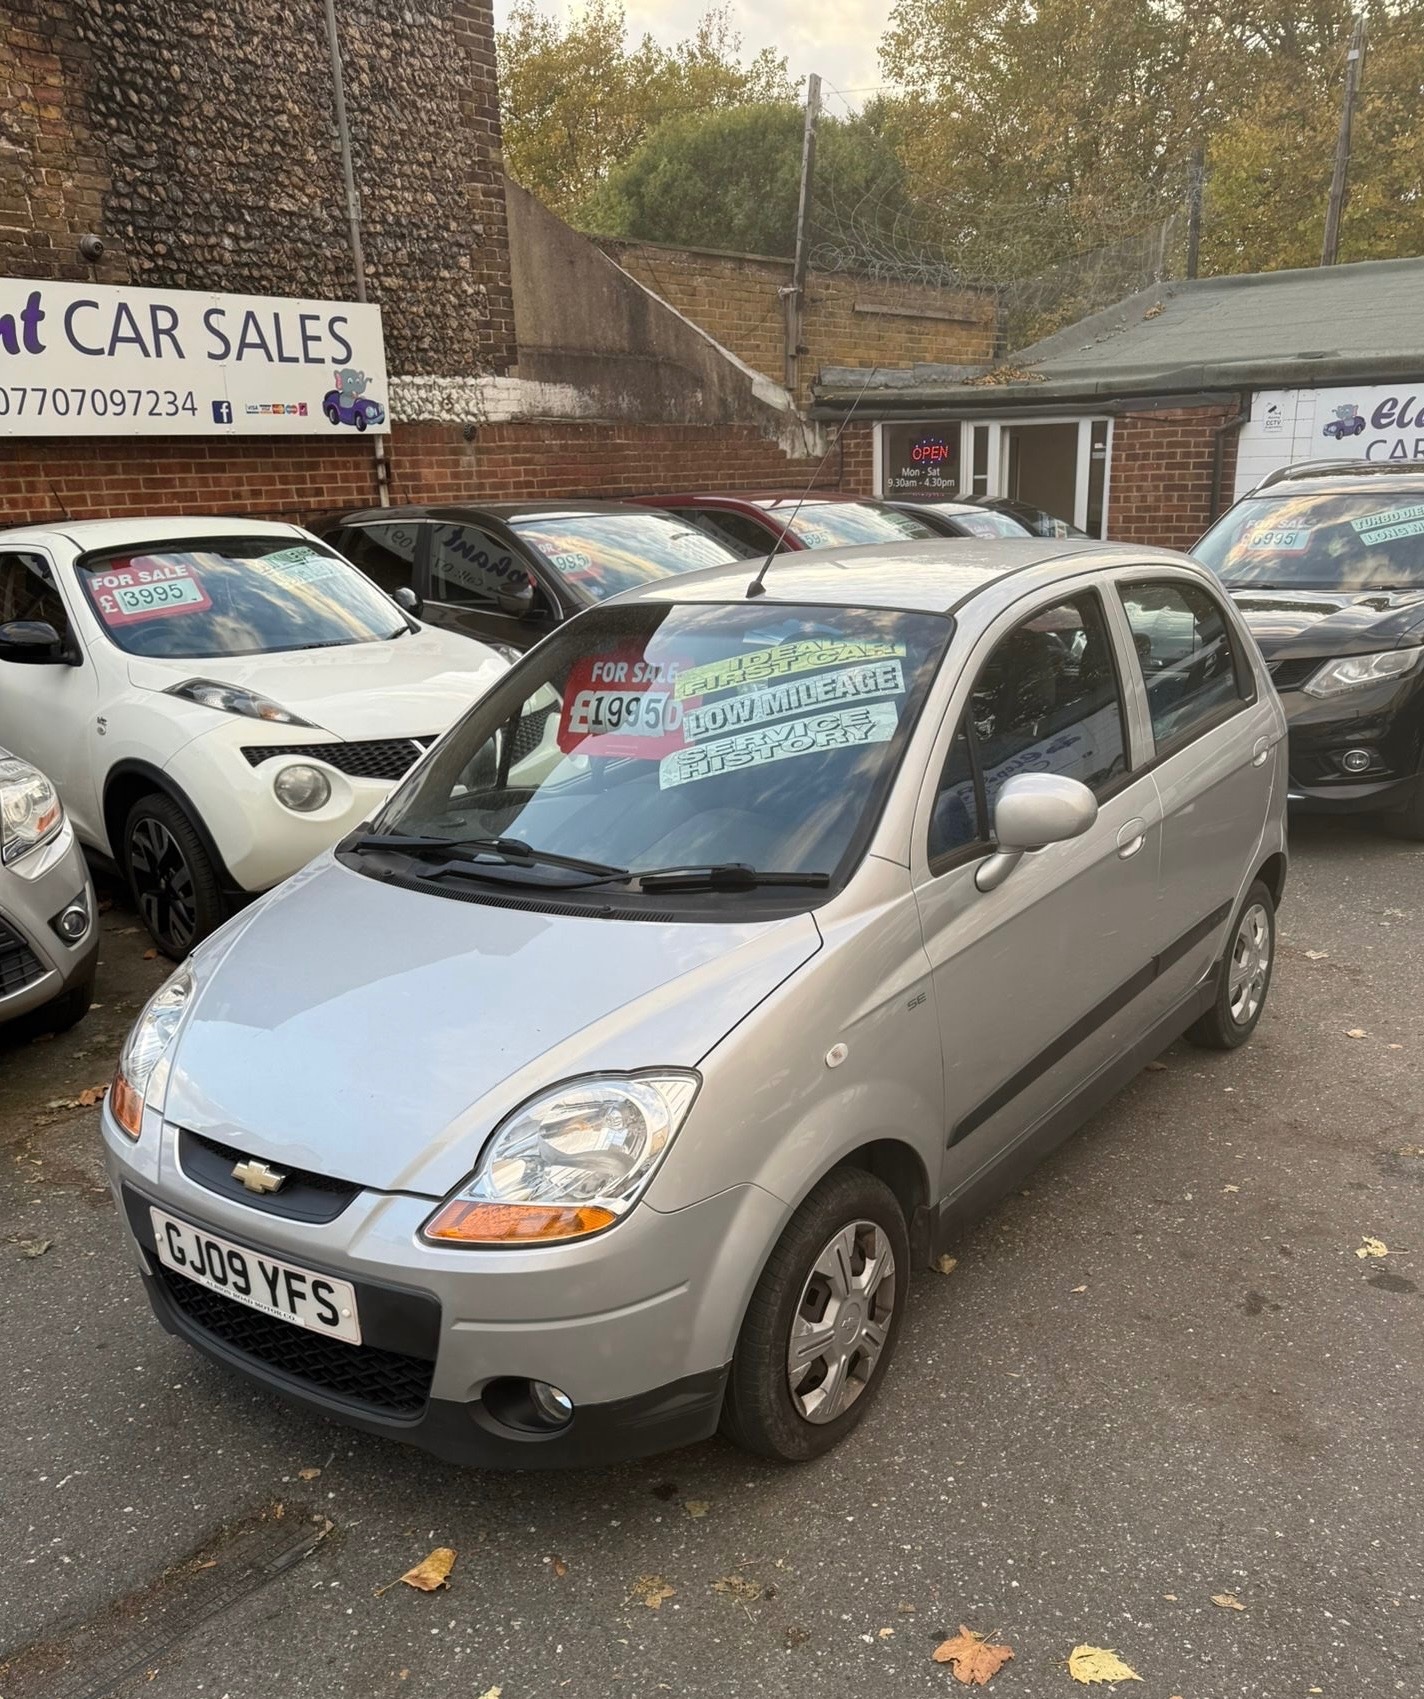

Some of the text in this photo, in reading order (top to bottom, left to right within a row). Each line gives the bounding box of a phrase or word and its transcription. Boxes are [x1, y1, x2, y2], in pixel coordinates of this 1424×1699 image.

[64, 300, 185, 359] CAR
[203, 308, 352, 365] SALES
[0, 387, 198, 417] 07707097234
[912, 446, 949, 460] OPEN
[887, 478, 917, 488] 9.30am
[924, 478, 955, 488] 4.30pm
[902, 467, 921, 477] Mon
[927, 467, 940, 477] Sat
[92, 565, 189, 590] FOR SALE
[123, 583, 184, 607] 3995
[684, 643, 899, 696] FIRST CAR
[730, 639, 847, 672] IDEAL
[591, 661, 680, 683] FOR SALE
[688, 664, 898, 736] LOW MILEAGE
[677, 707, 872, 765] SERVICE
[679, 720, 877, 780] HISTORY
[906, 991, 927, 1011] SE
[165, 1221, 340, 1327] GJ09 YFS
